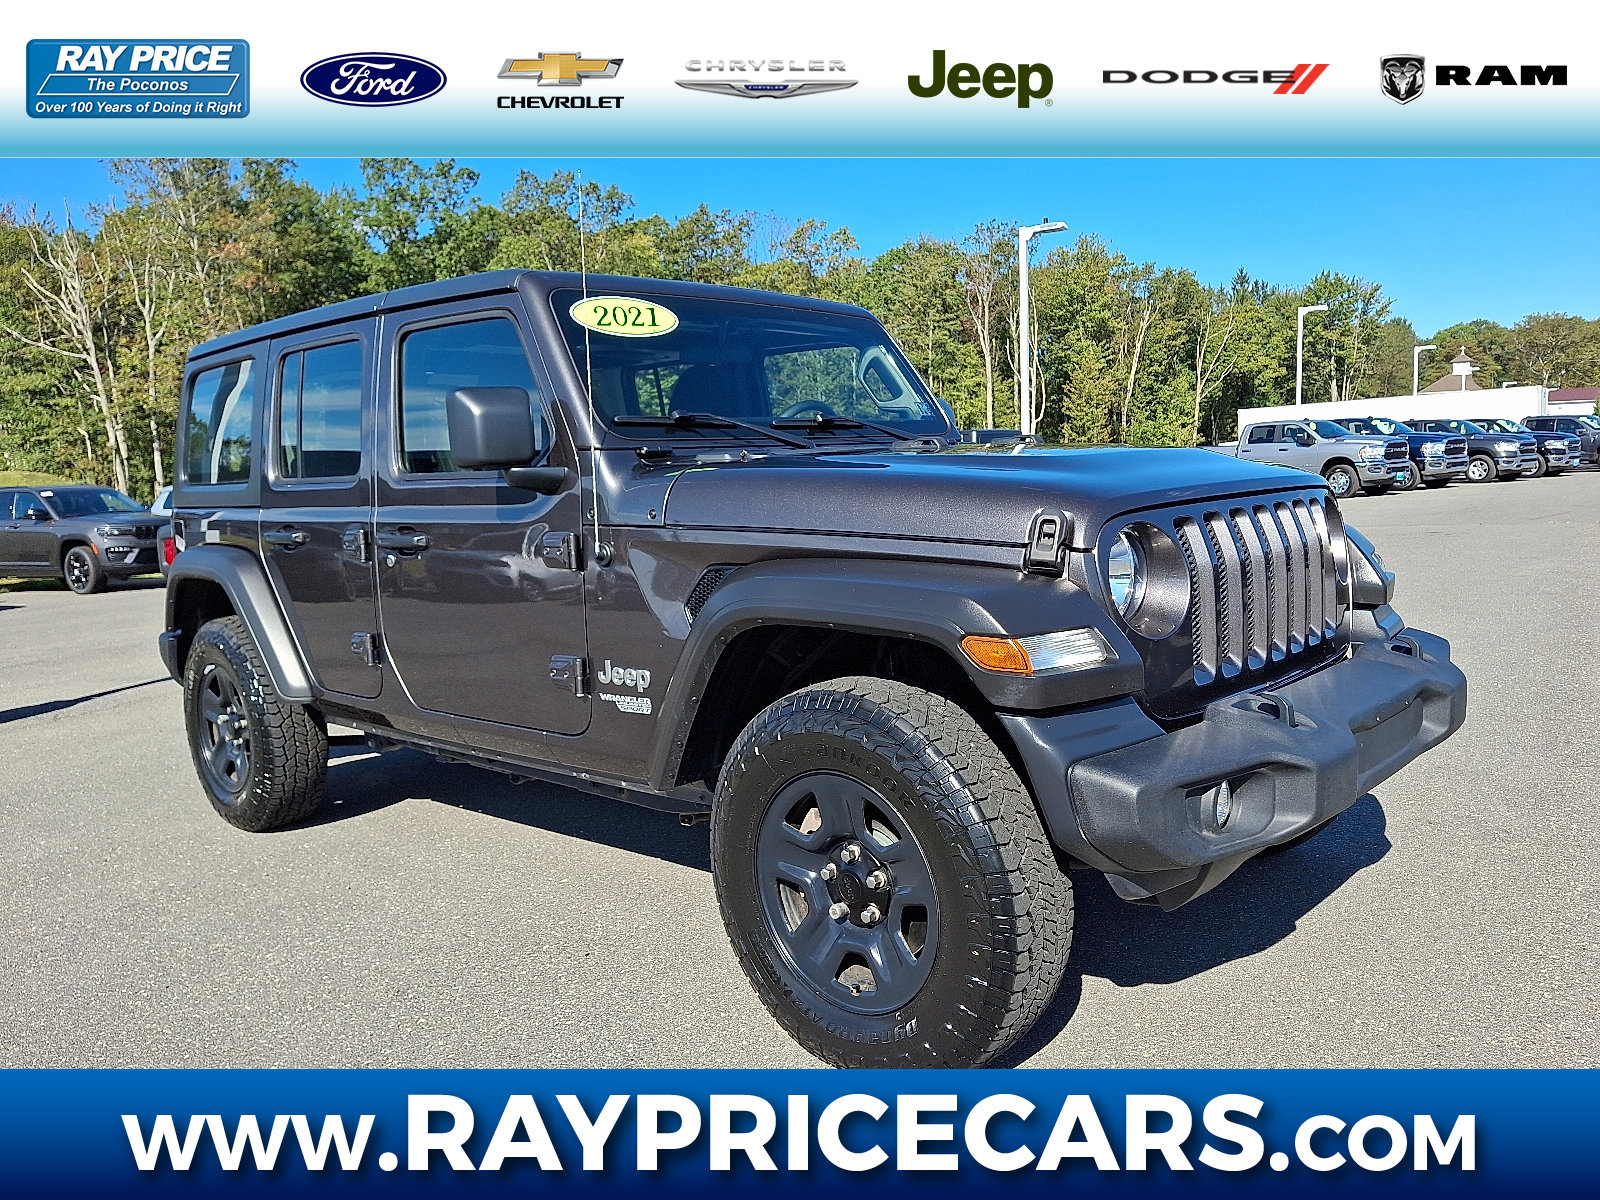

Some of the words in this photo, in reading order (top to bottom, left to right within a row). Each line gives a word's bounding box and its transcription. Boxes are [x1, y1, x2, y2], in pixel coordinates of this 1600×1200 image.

[593, 305, 661, 327] 2021
[597, 659, 651, 693] Jeep
[599, 692, 652, 705] WRANGLER
